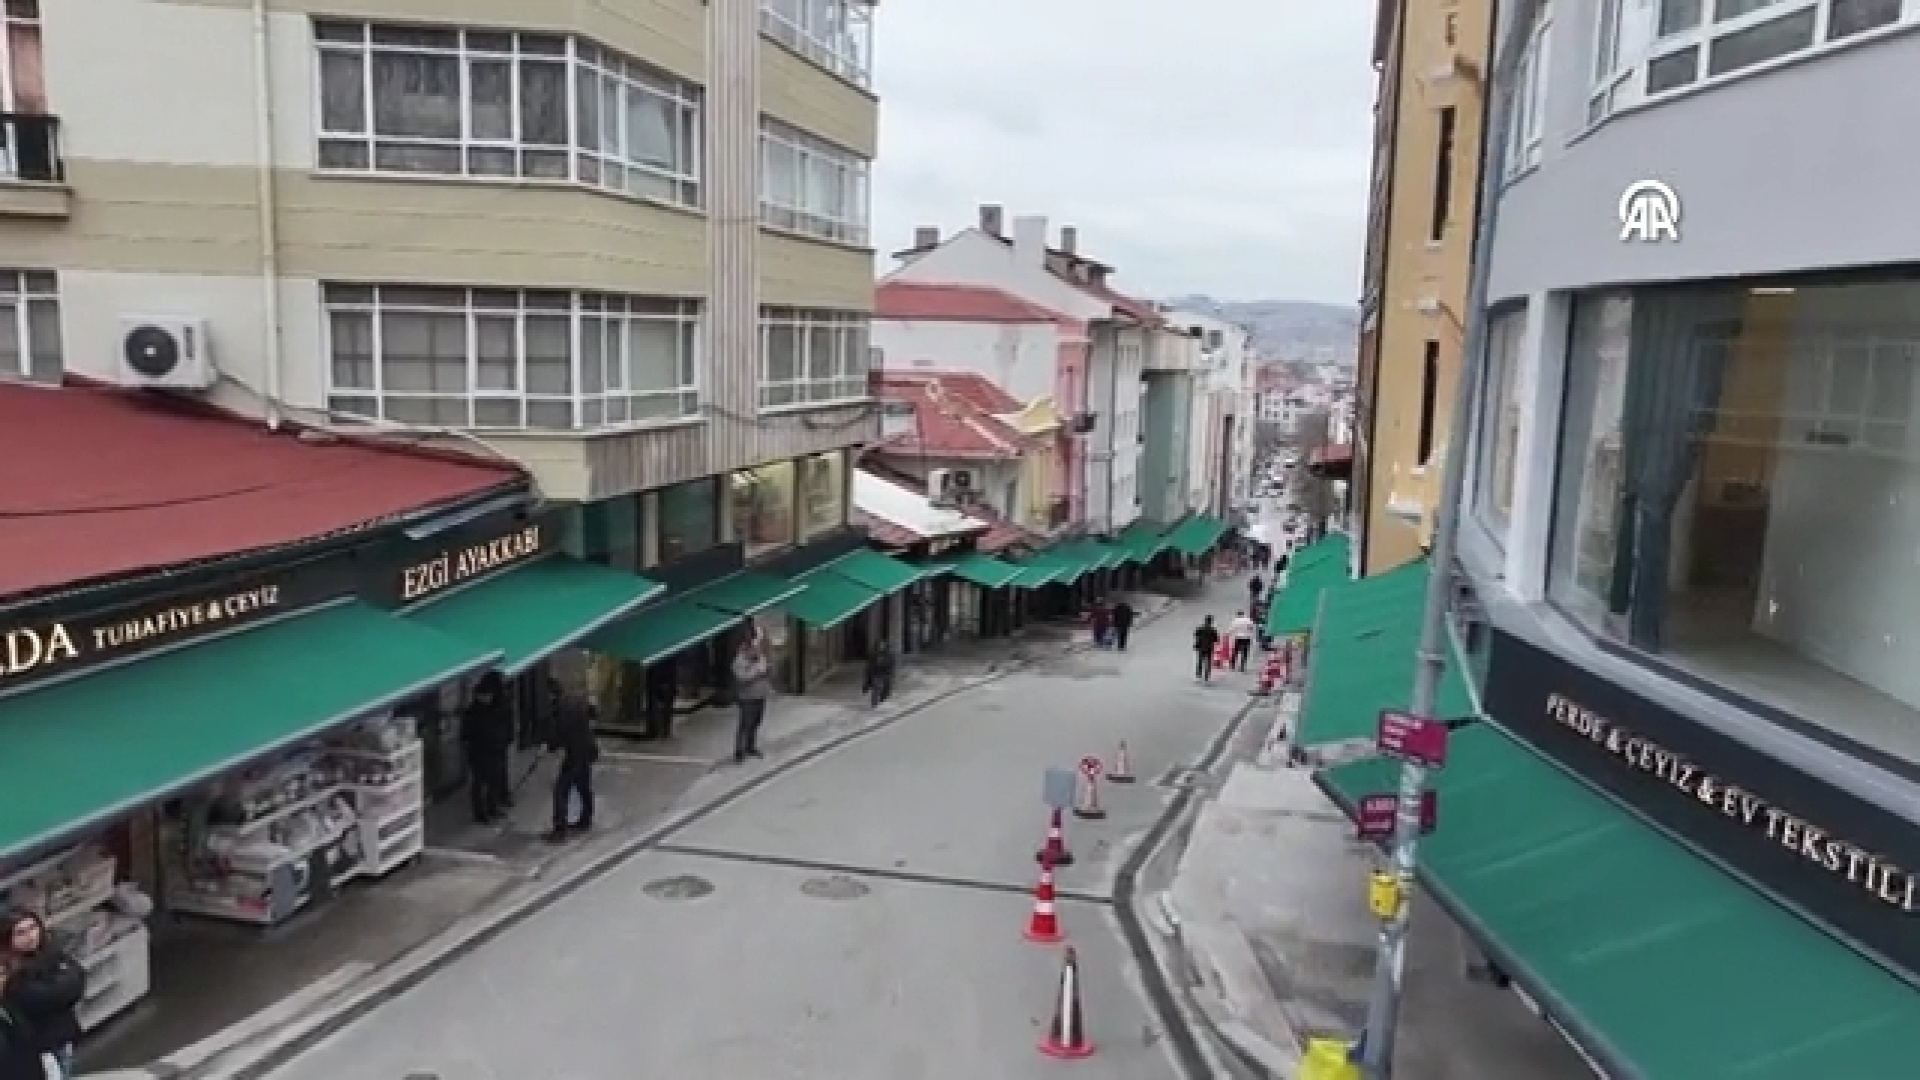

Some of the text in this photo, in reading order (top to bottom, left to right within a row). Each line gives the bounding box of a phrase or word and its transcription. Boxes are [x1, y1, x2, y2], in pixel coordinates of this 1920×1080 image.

[403, 524, 539, 598] EZGİ AYAKKABI
[0, 623, 78, 675] DA
[1546, 693, 1609, 742] PERDE
[1607, 727, 1624, 753] &
[1696, 776, 1720, 805] &
[1723, 785, 1767, 824] EV
